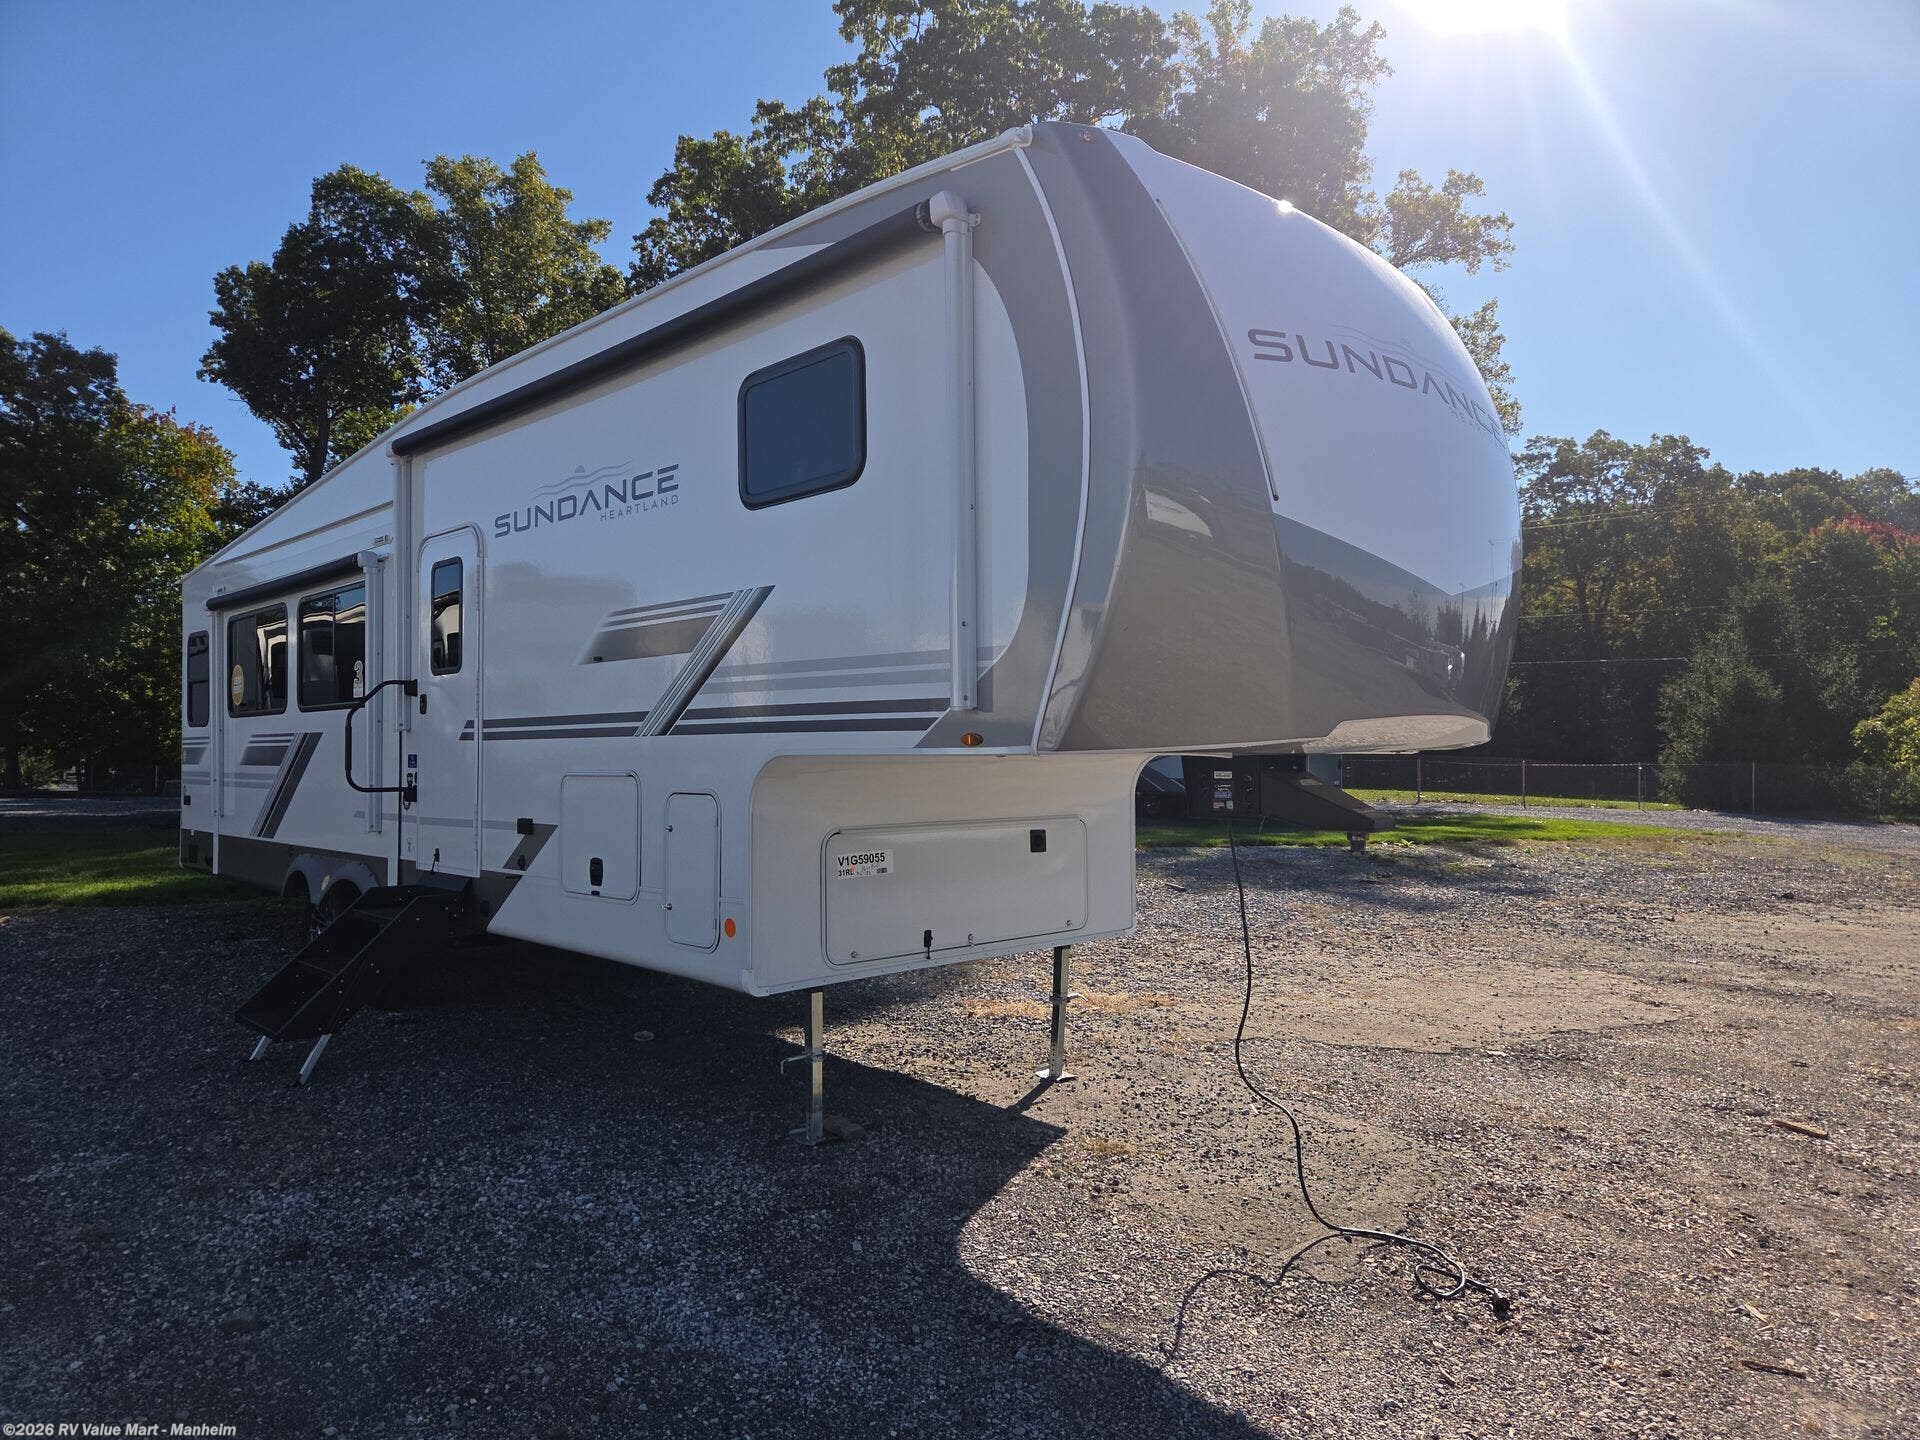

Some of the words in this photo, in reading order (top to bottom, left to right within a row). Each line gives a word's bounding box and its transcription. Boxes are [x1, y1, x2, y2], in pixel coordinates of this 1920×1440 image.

[1247, 328, 1506, 449] SUNDANCE
[494, 463, 679, 538] SUNDANCE
[600, 495, 679, 521] HEARTLAND
[837, 852, 885, 867] V1G59055
